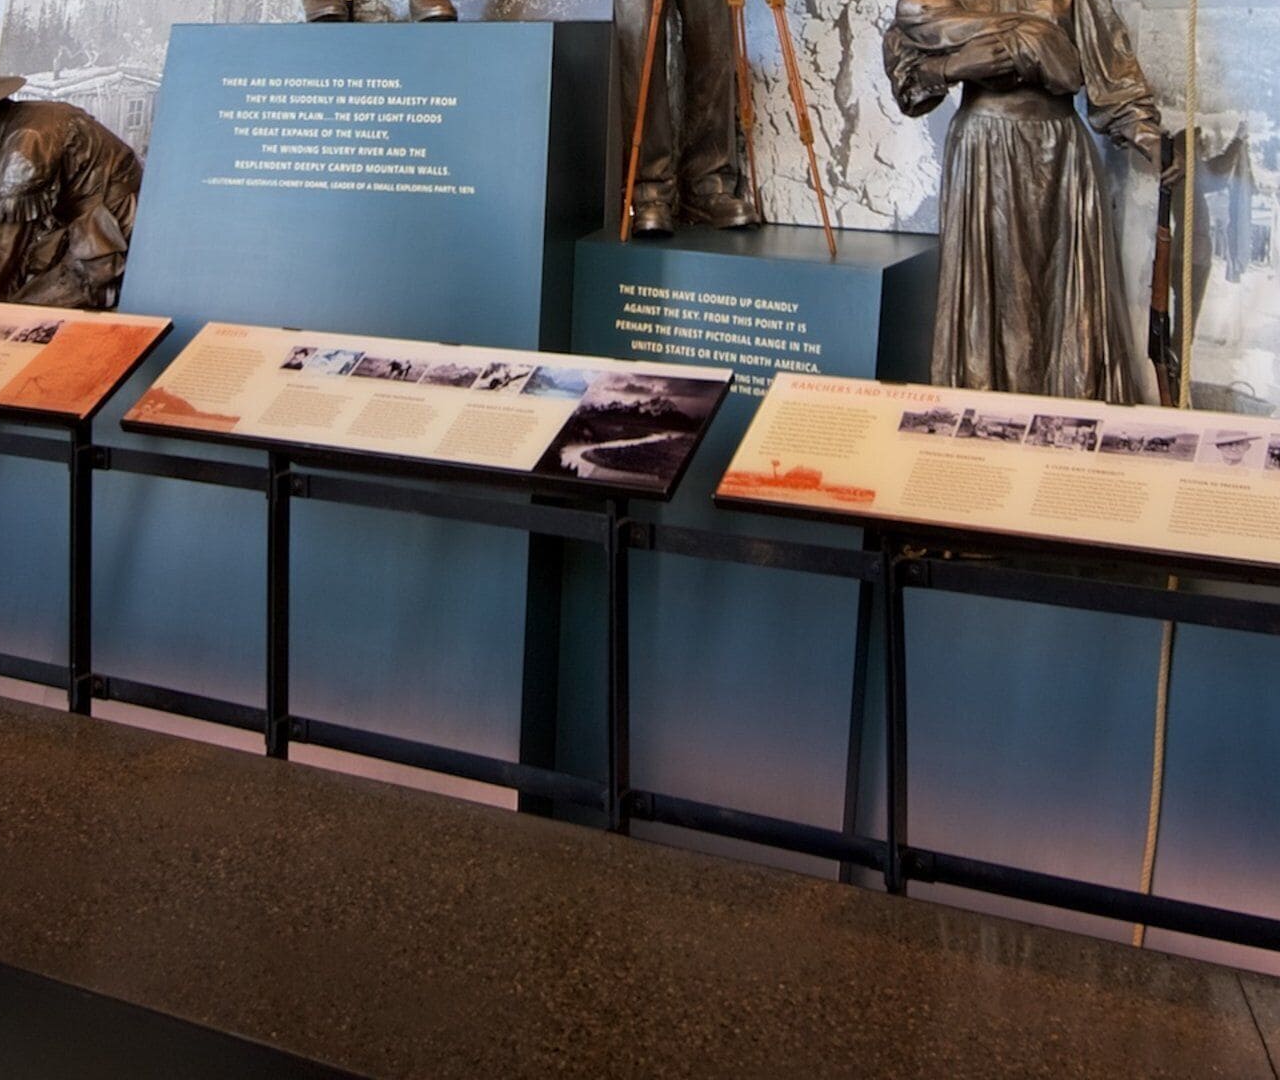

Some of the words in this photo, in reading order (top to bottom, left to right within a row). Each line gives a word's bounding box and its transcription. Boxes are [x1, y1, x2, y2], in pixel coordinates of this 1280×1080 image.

[222, 78, 248, 87] THERE
[250, 78, 266, 87] ARE
[268, 78, 282, 87] NO
[284, 78, 330, 88] FOOTHILLS
[332, 79, 345, 88] TO
[347, 79, 363, 88] THE
[246, 94, 268, 103] THEY
[269, 95, 287, 103] RISE
[289, 95, 334, 104] SUDDENLY
[336, 96, 346, 104] IN
[348, 96, 385, 105] RUGGED
[387, 96, 428, 106] MAJESTY
[430, 97, 457, 106] FROM
[218, 110, 234, 120] THE
[236, 110, 260, 120] ROCK
[262, 111, 296, 120] STREWN
[334, 112, 351, 121] THE
[353, 112, 376, 122] SOFT
[377, 113, 404, 122] LIGHT
[406, 114, 442, 123] FLOODS
[234, 126, 250, 136] THE
[251, 127, 280, 136] GREAT
[281, 128, 319, 138] EXPANSE
[321, 129, 333, 138] OF
[336, 129, 352, 138] THE
[262, 144, 278, 154] THE
[280, 145, 320, 154] WINDING
[321, 146, 356, 155] SILVERY
[358, 147, 384, 156] RIVER
[386, 148, 407, 157] AND
[409, 148, 426, 158] THE
[234, 160, 292, 170] RESPLENDENT
[293, 162, 326, 172] DEEPLY
[328, 163, 364, 173] CARVED
[365, 164, 415, 174] MOUNTAIN
[619, 284, 635, 295] THE
[638, 286, 670, 299] TETONS
[672, 290, 696, 302] HAVE
[698, 293, 737, 306] LOOMED
[739, 297, 752, 308] UP
[754, 299, 799, 313] GRANDLY
[623, 303, 661, 315] AGAINST
[663, 307, 680, 318] THE
[682, 309, 700, 320] SKY.
[703, 312, 730, 324] FROM
[732, 315, 752, 327] THIS
[754, 318, 783, 330] POINT
[785, 322, 795, 331] IT
[797, 323, 807, 333] IS
[615, 320, 653, 333] PERHAPS
[655, 324, 672, 336] THE
[673, 326, 703, 339] FINEST
[705, 330, 752, 346] PICTORIAL
[754, 337, 787, 350] RANGE
[789, 341, 800, 351] IN
[803, 342, 821, 355] THE
[631, 340, 663, 353] UNITED
[665, 344, 696, 357] STATES
[697, 348, 711, 359] OR
[713, 350, 737, 362] EVEN
[739, 354, 772, 367] NORTH
[774, 358, 820, 374] AMERICA.
[752, 375, 766, 386] THE
[791, 382, 851, 394] RANCHERS
[855, 387, 881, 397] AND
[887, 390, 941, 403] SETTLERS
